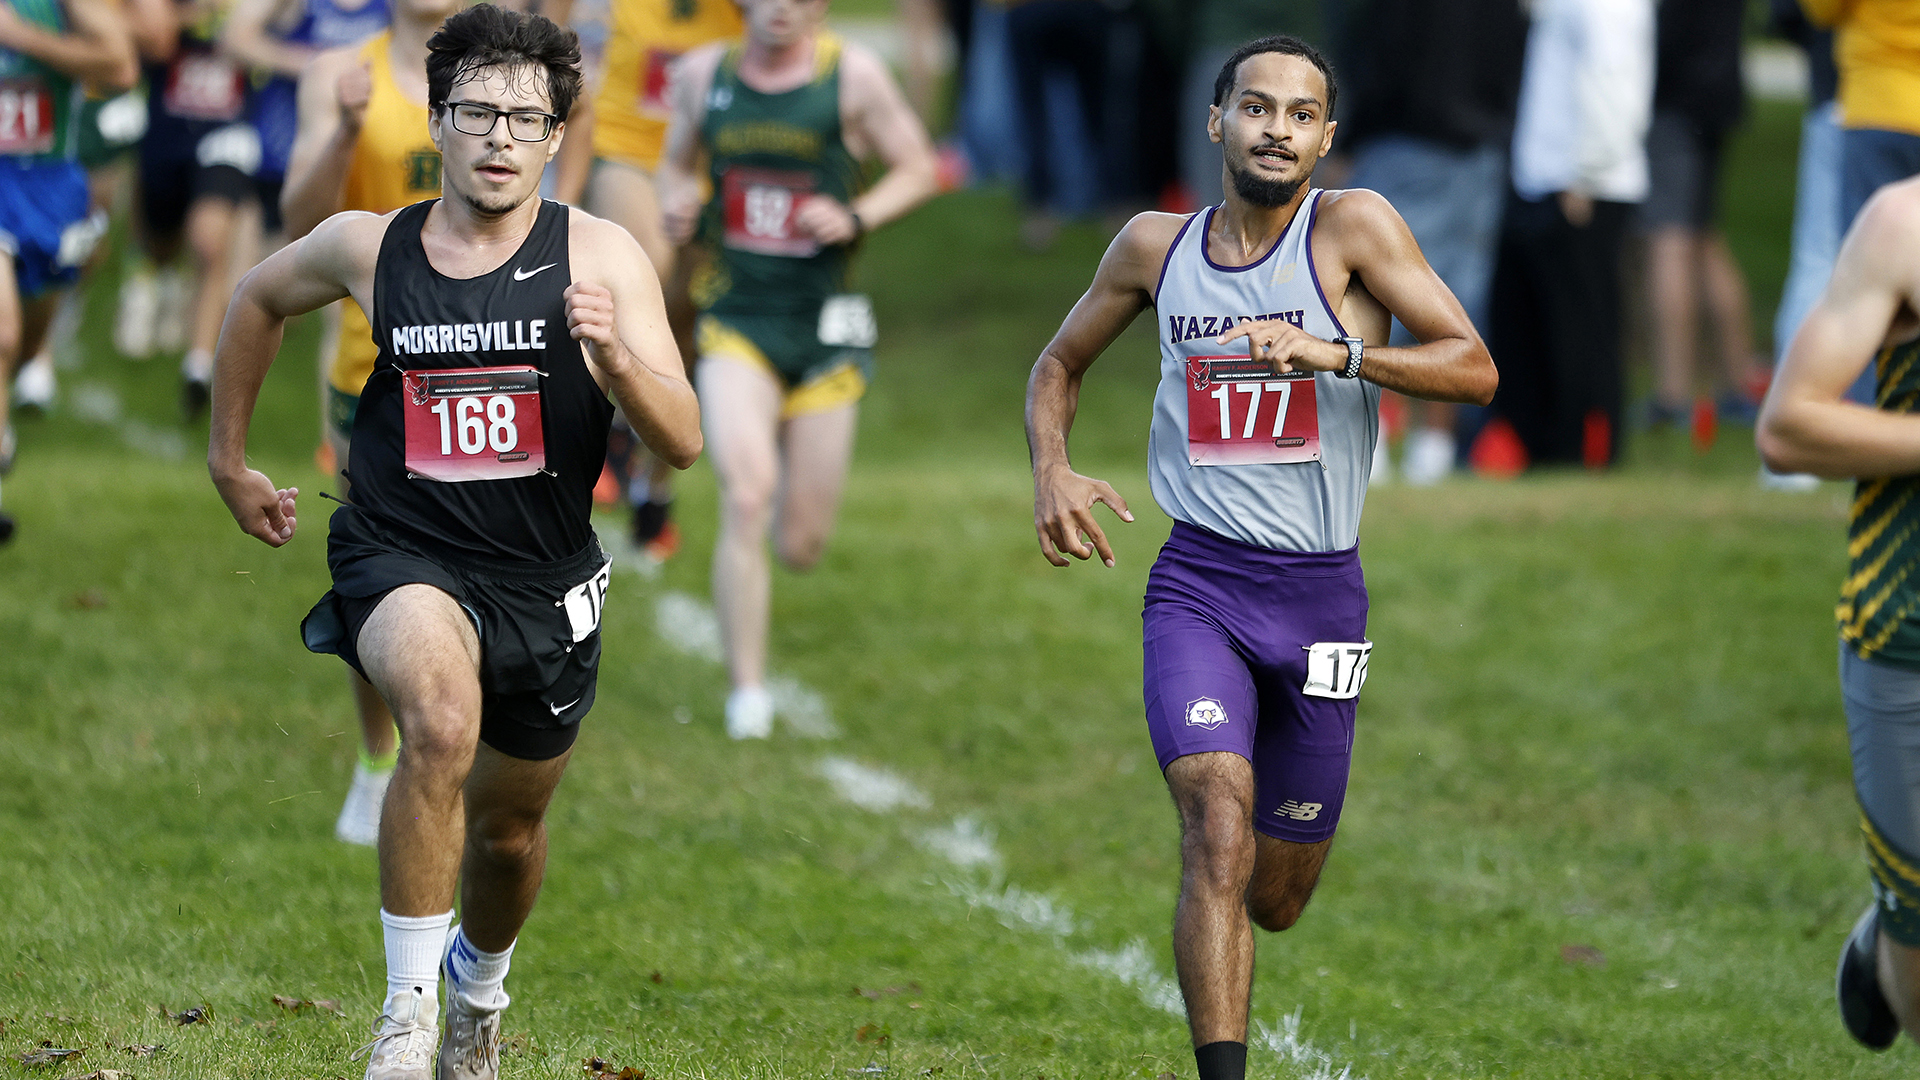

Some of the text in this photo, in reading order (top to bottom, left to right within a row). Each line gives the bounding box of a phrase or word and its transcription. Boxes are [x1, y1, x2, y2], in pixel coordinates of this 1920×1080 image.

[392, 319, 547, 356] MORRISVILLE
[431, 395, 519, 456] 168
[1211, 382, 1292, 440] 177
